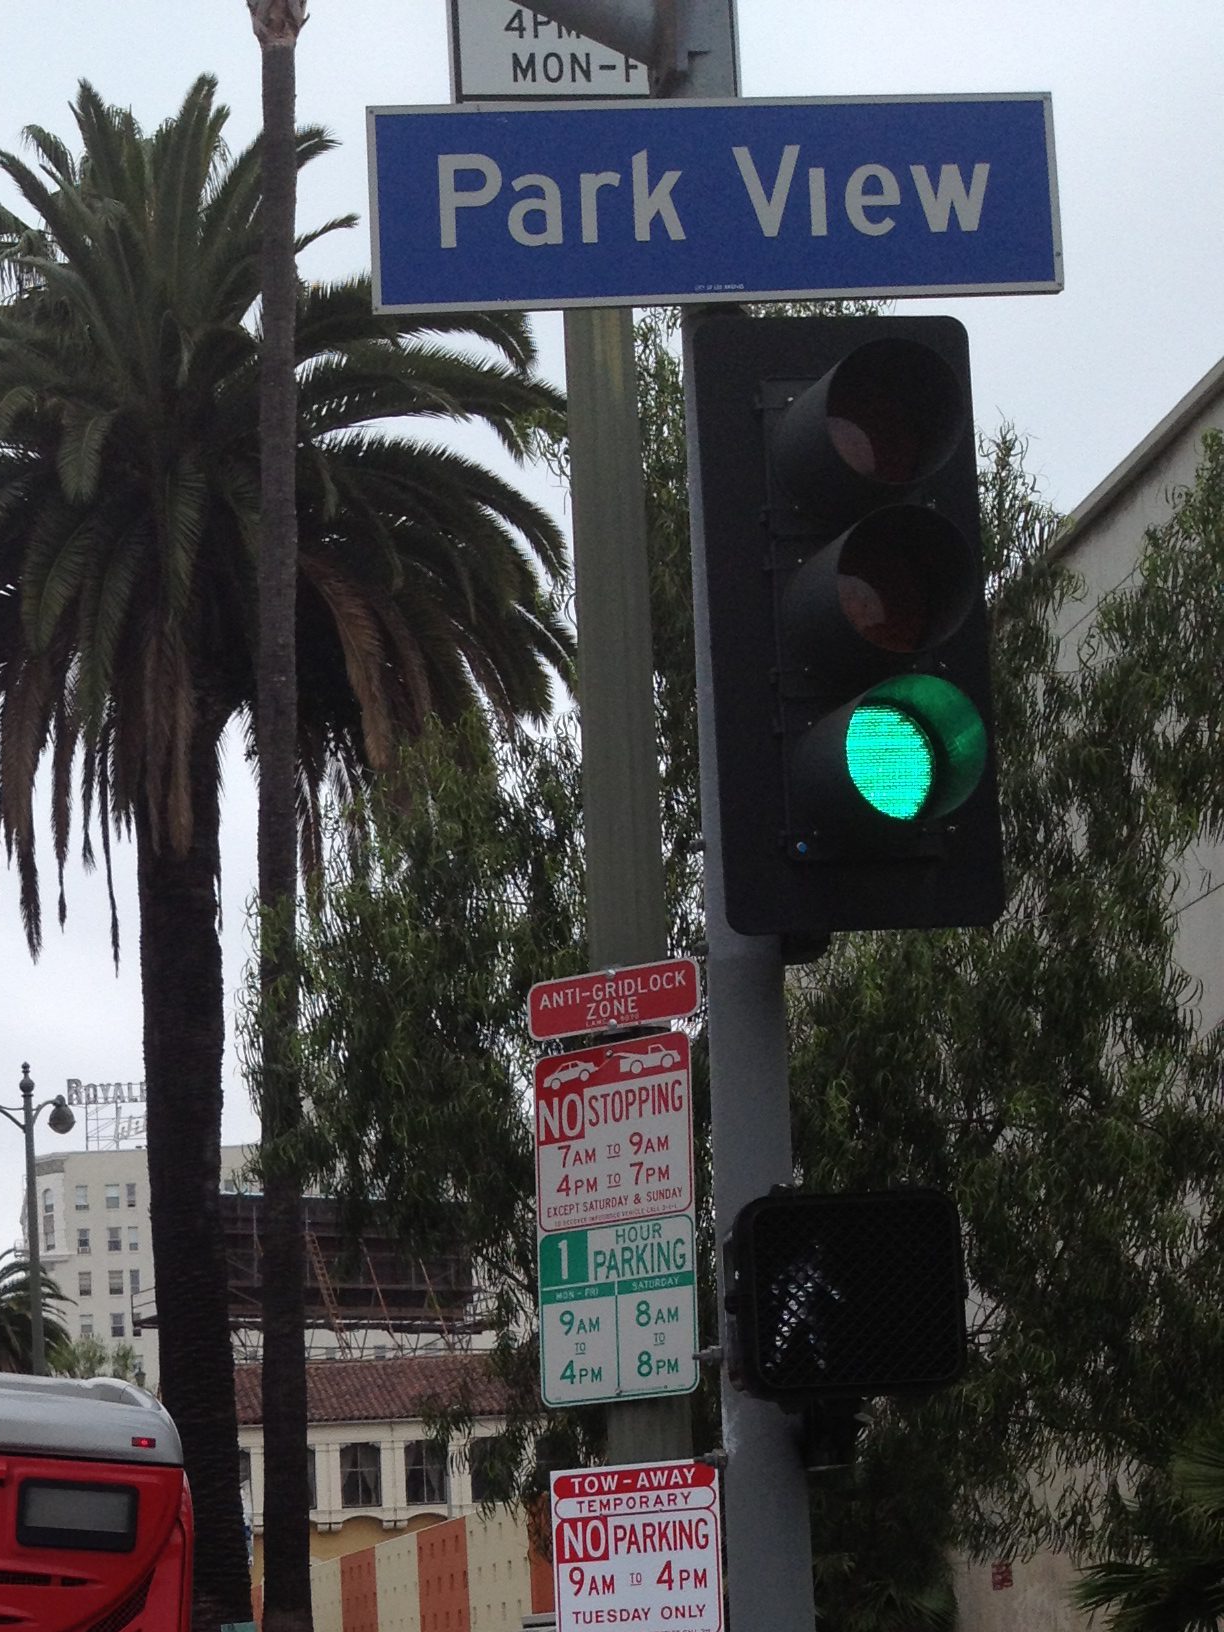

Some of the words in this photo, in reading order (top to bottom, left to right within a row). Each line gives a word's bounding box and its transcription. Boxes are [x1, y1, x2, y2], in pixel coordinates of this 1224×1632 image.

[436, 149, 685, 249] Park
[731, 144, 990, 238] View
[539, 969, 687, 1010] ANTI-GRIDLOCK
[586, 996, 639, 1021] ZONE
[539, 1092, 584, 1142] NO
[588, 1079, 684, 1128] STOPPING
[557, 1145, 597, 1169] 7AM
[607, 1143, 621, 1158] TO
[629, 1132, 669, 1155] 9AM
[556, 1174, 598, 1197] 4PM
[607, 1173, 621, 1187] TO
[630, 1161, 670, 1185] 7PM
[547, 1201, 580, 1217] EXCEPT
[583, 1194, 629, 1212] SATURDAY
[633, 1192, 642, 1204] &
[646, 1186, 683, 1201] SUNDAY
[558, 1239, 569, 1280] 1
[615, 1223, 663, 1245] HOUR
[593, 1238, 687, 1281] PARKING
[631, 1276, 680, 1291] SATURDAY
[559, 1309, 600, 1336] 9AM
[635, 1300, 679, 1327] 8AM
[575, 1342, 586, 1353] TO
[653, 1332, 665, 1344] TO
[560, 1360, 603, 1385] 4PM
[637, 1351, 679, 1378] 8PM
[577, 1491, 692, 1514] TEMPORARY
[563, 1519, 606, 1560] NO
[614, 1518, 709, 1556] PARKING
[568, 1566, 615, 1597] 9AM
[629, 1572, 642, 1585] TO
[656, 1560, 708, 1591] 4PM
[572, 1607, 651, 1625] TUESDAY
[660, 1604, 706, 1620] ONLY
